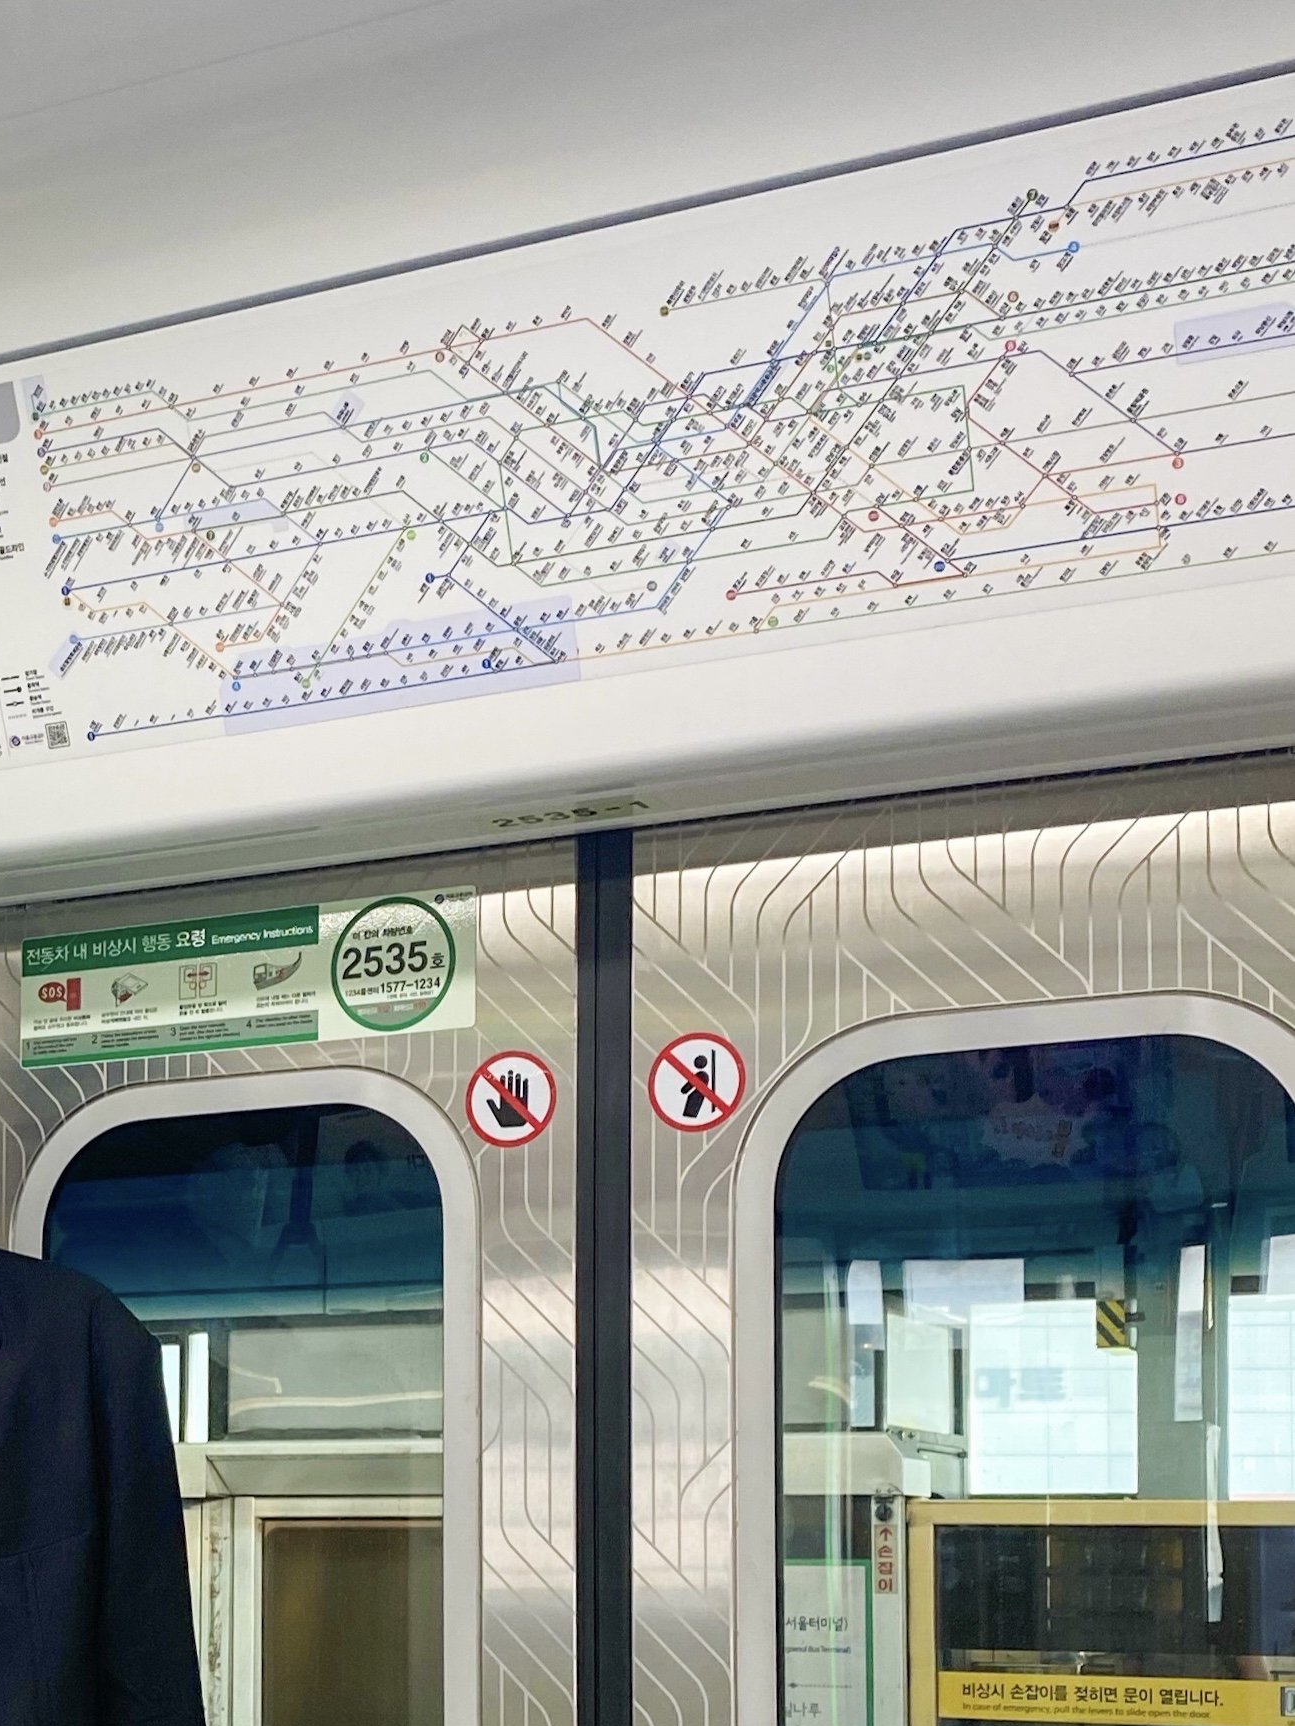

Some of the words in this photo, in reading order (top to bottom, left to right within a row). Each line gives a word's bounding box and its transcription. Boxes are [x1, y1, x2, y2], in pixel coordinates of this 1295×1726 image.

[211, 931, 262, 945] Emergency
[263, 925, 313, 939] Instructions
[26, 946, 69, 966] 전동차
[73, 943, 87, 960] 내
[92, 938, 137, 957] 비상시
[141, 933, 172, 954] 행동
[175, 928, 206, 948] 요령
[41, 985, 63, 1000] SOS
[380, 977, 440, 994] 1577-1234
[878, 1545, 893, 1592] 손잡이
[962, 1682, 1005, 1700] 비상시
[1010, 1683, 1068, 1701] 손잡이를
[1123, 1687, 1153, 1705] 문이
[1159, 1688, 1224, 1707] 열립니다.
[972, 1704, 991, 1712] case
[992, 1703, 1002, 1711] of
[1054, 1705, 1070, 1715] pull
[1072, 1706, 1085, 1714] the
[1088, 1707, 1113, 1715] levers
[1115, 1708, 1124, 1716] to
[1126, 1708, 1146, 1717] slide
[1148, 1710, 1171, 1719] open
[1173, 1709, 1188, 1718] the
